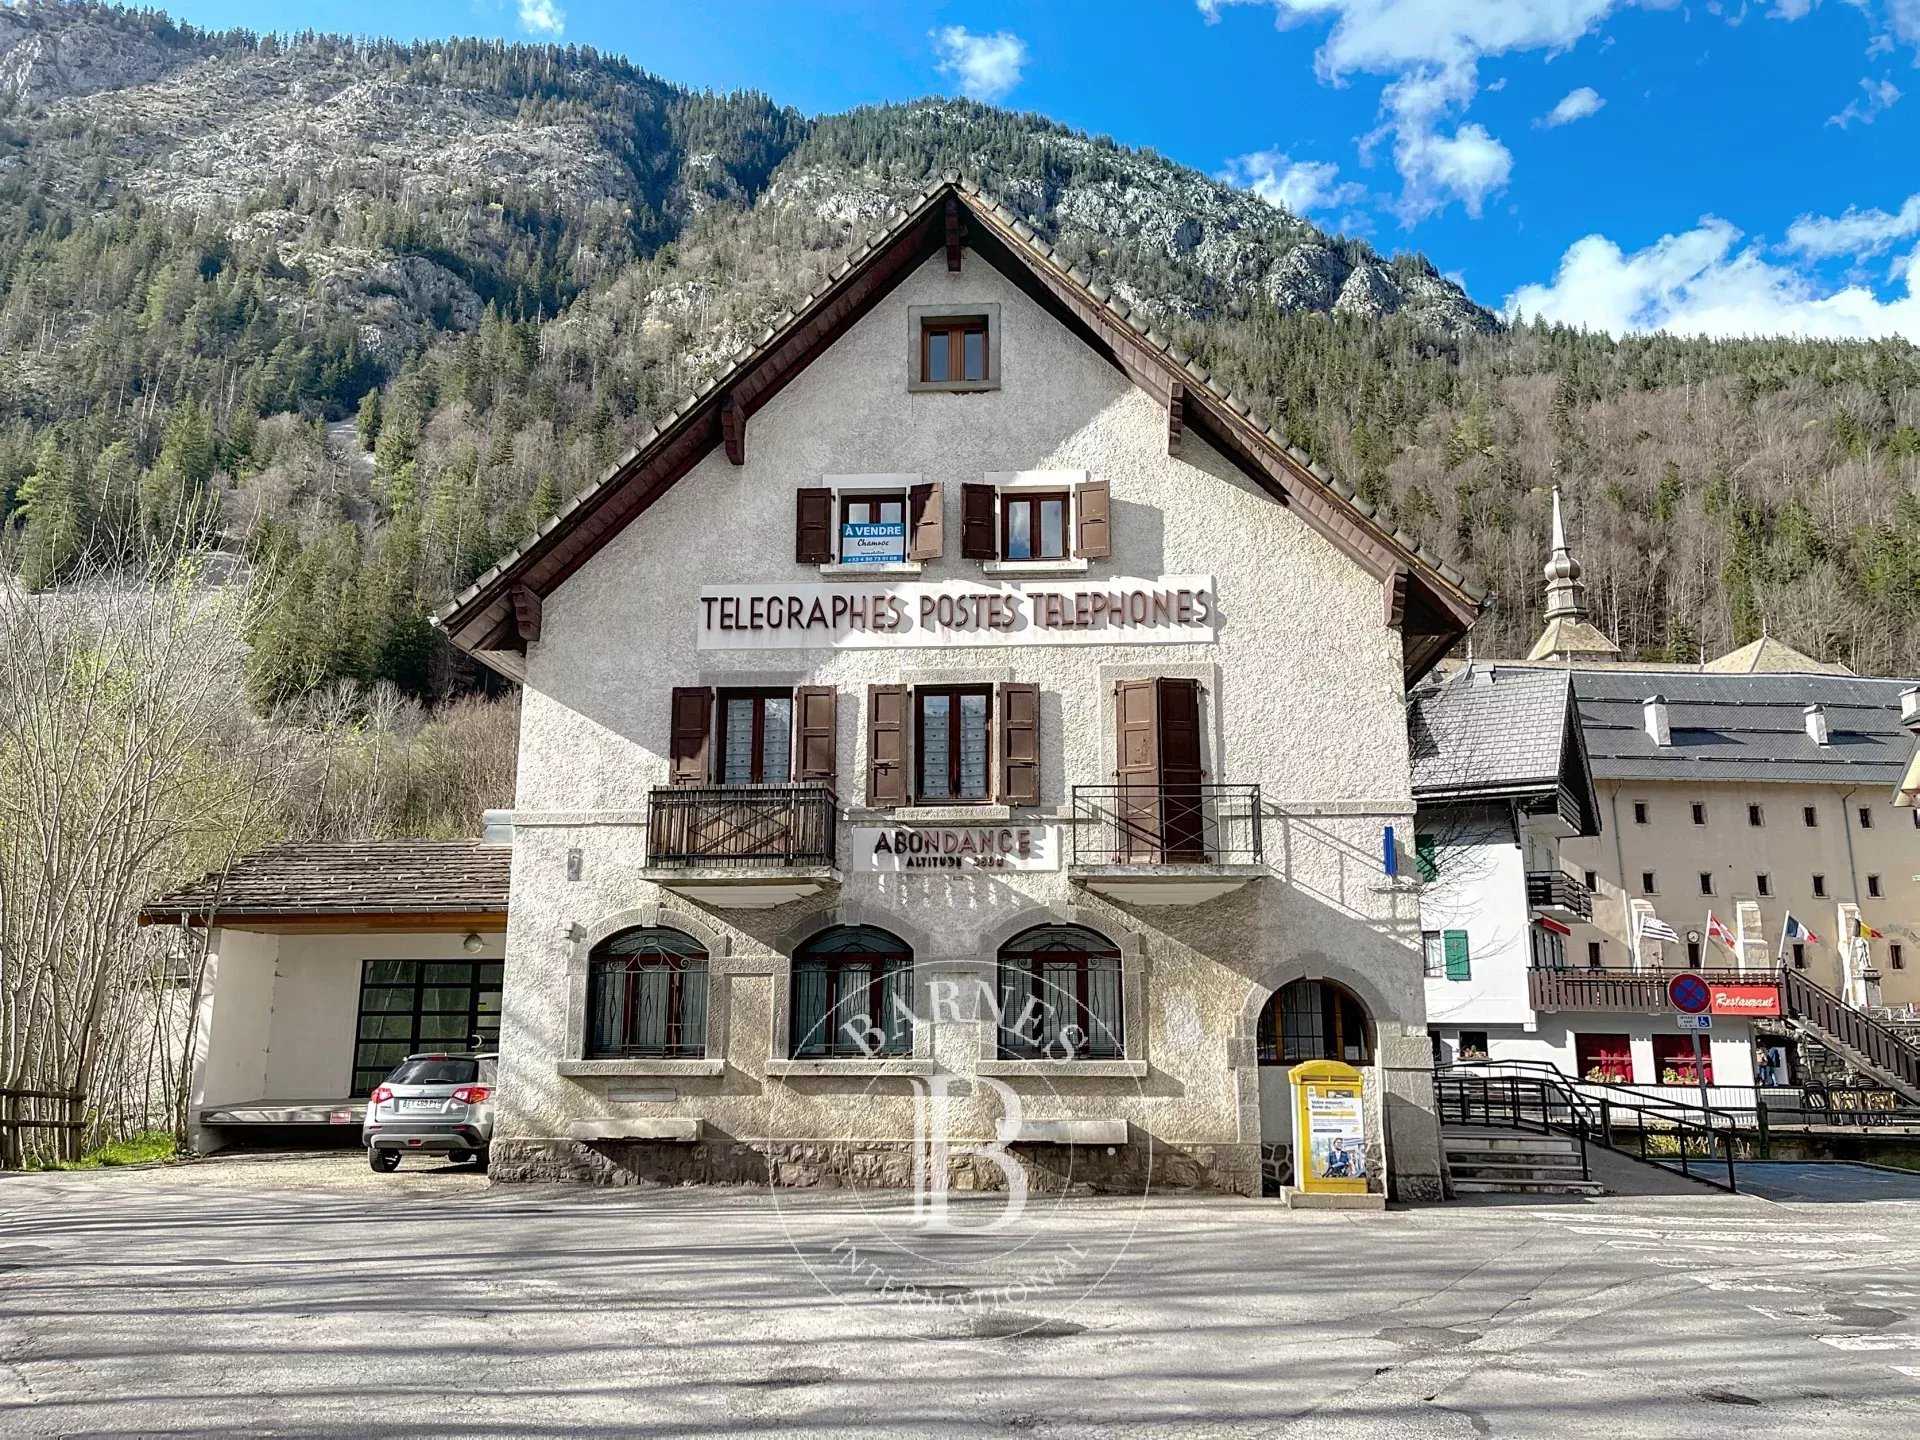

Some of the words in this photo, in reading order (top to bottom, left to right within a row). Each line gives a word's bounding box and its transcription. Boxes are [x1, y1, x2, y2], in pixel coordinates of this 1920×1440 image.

[845, 525, 854, 536] À
[855, 526, 901, 536] VENDRE
[700, 594, 901, 631] TELEGRAPHES
[919, 592, 1015, 628] POSTES
[1026, 588, 1209, 627] TELEPHONES
[874, 828, 1030, 857] ABONDANCE
[906, 856, 962, 868] ALTITUDE
[1715, 992, 1774, 1008] Restaurant
